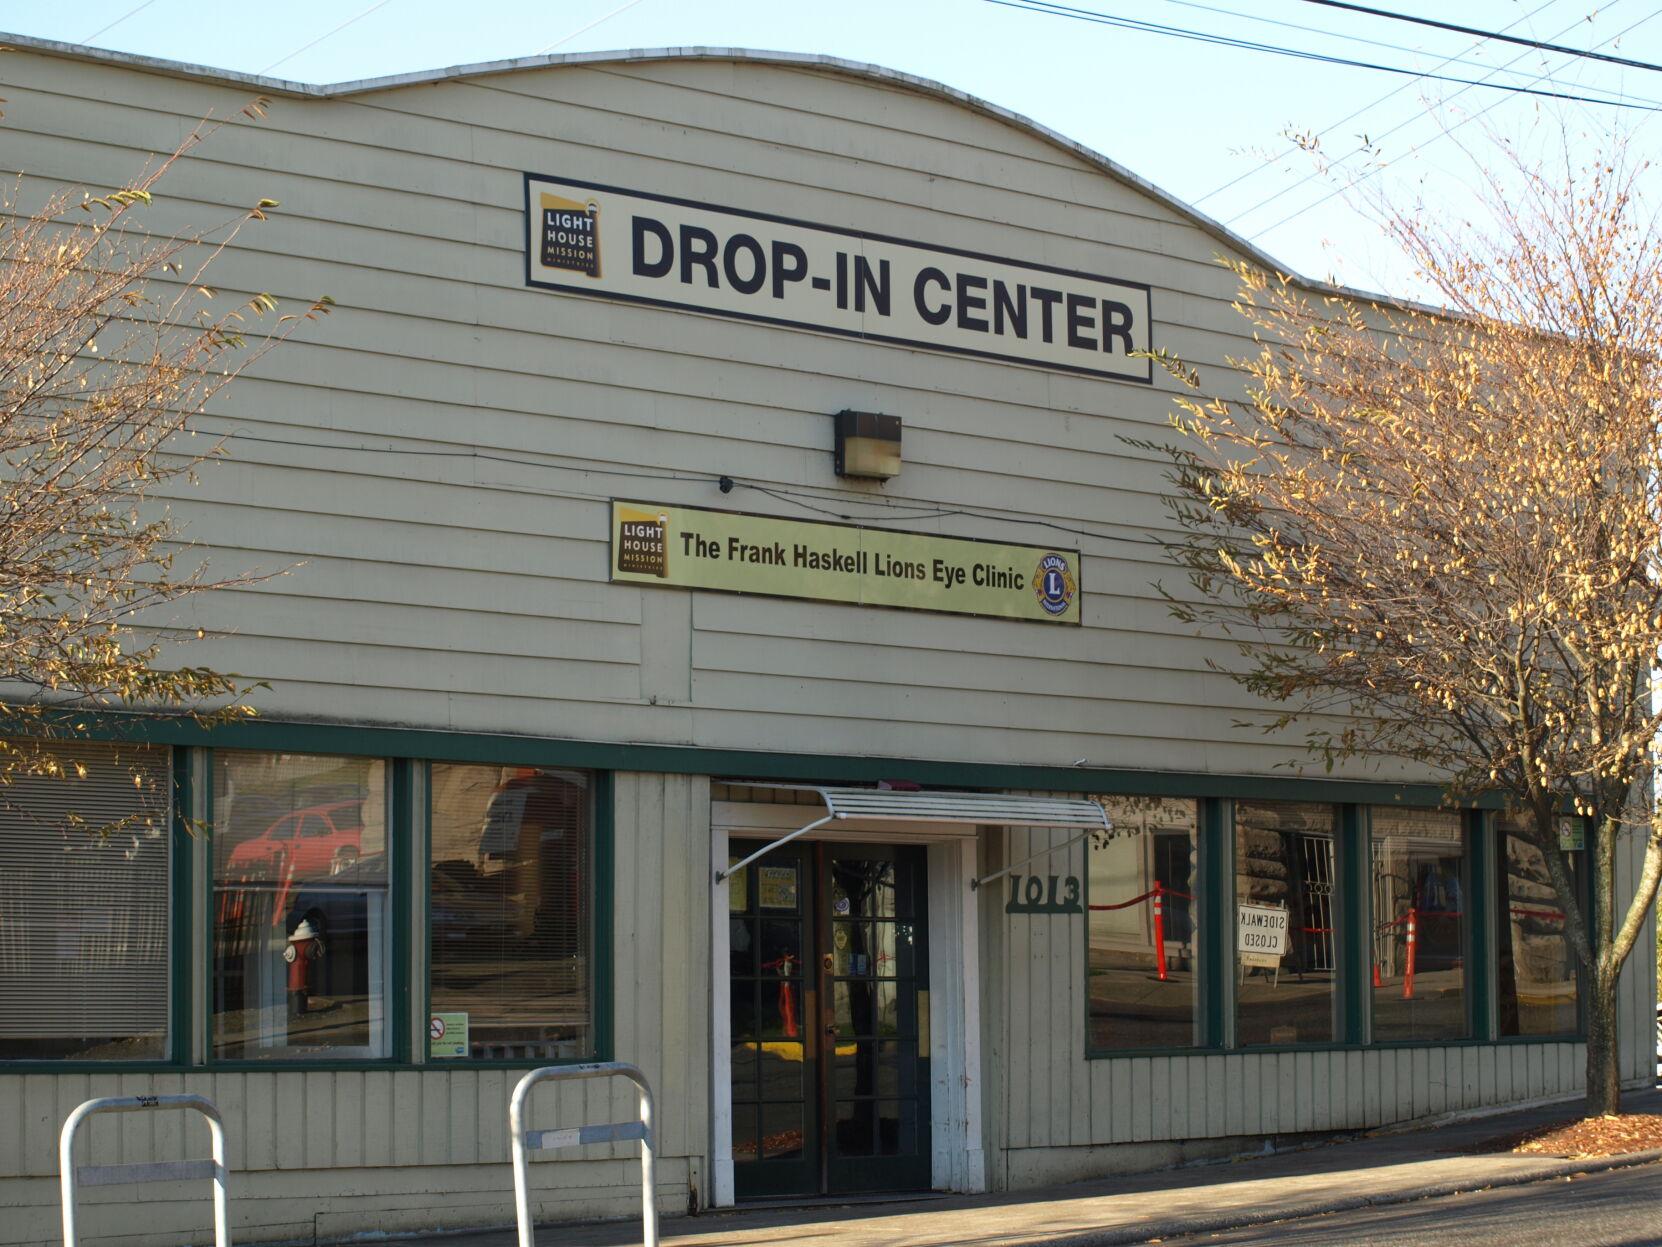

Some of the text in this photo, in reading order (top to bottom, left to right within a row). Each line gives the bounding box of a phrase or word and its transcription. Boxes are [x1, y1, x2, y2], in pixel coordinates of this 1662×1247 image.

[547, 212, 593, 232] LIGHT
[547, 229, 593, 248] HOUSE
[547, 246, 593, 260] MISSION
[631, 215, 1135, 357] DROP-IN CENTER
[624, 524, 663, 539] LIGHT
[624, 540, 663, 553] HOUSE
[623, 553, 663, 563] MISSION
[680, 531, 1025, 591] The Frank Haskell Lions Eye Clinic
[1043, 556, 1065, 571] LIONS
[1048, 572, 1061, 595] L
[1009, 875, 1081, 906] 1013
